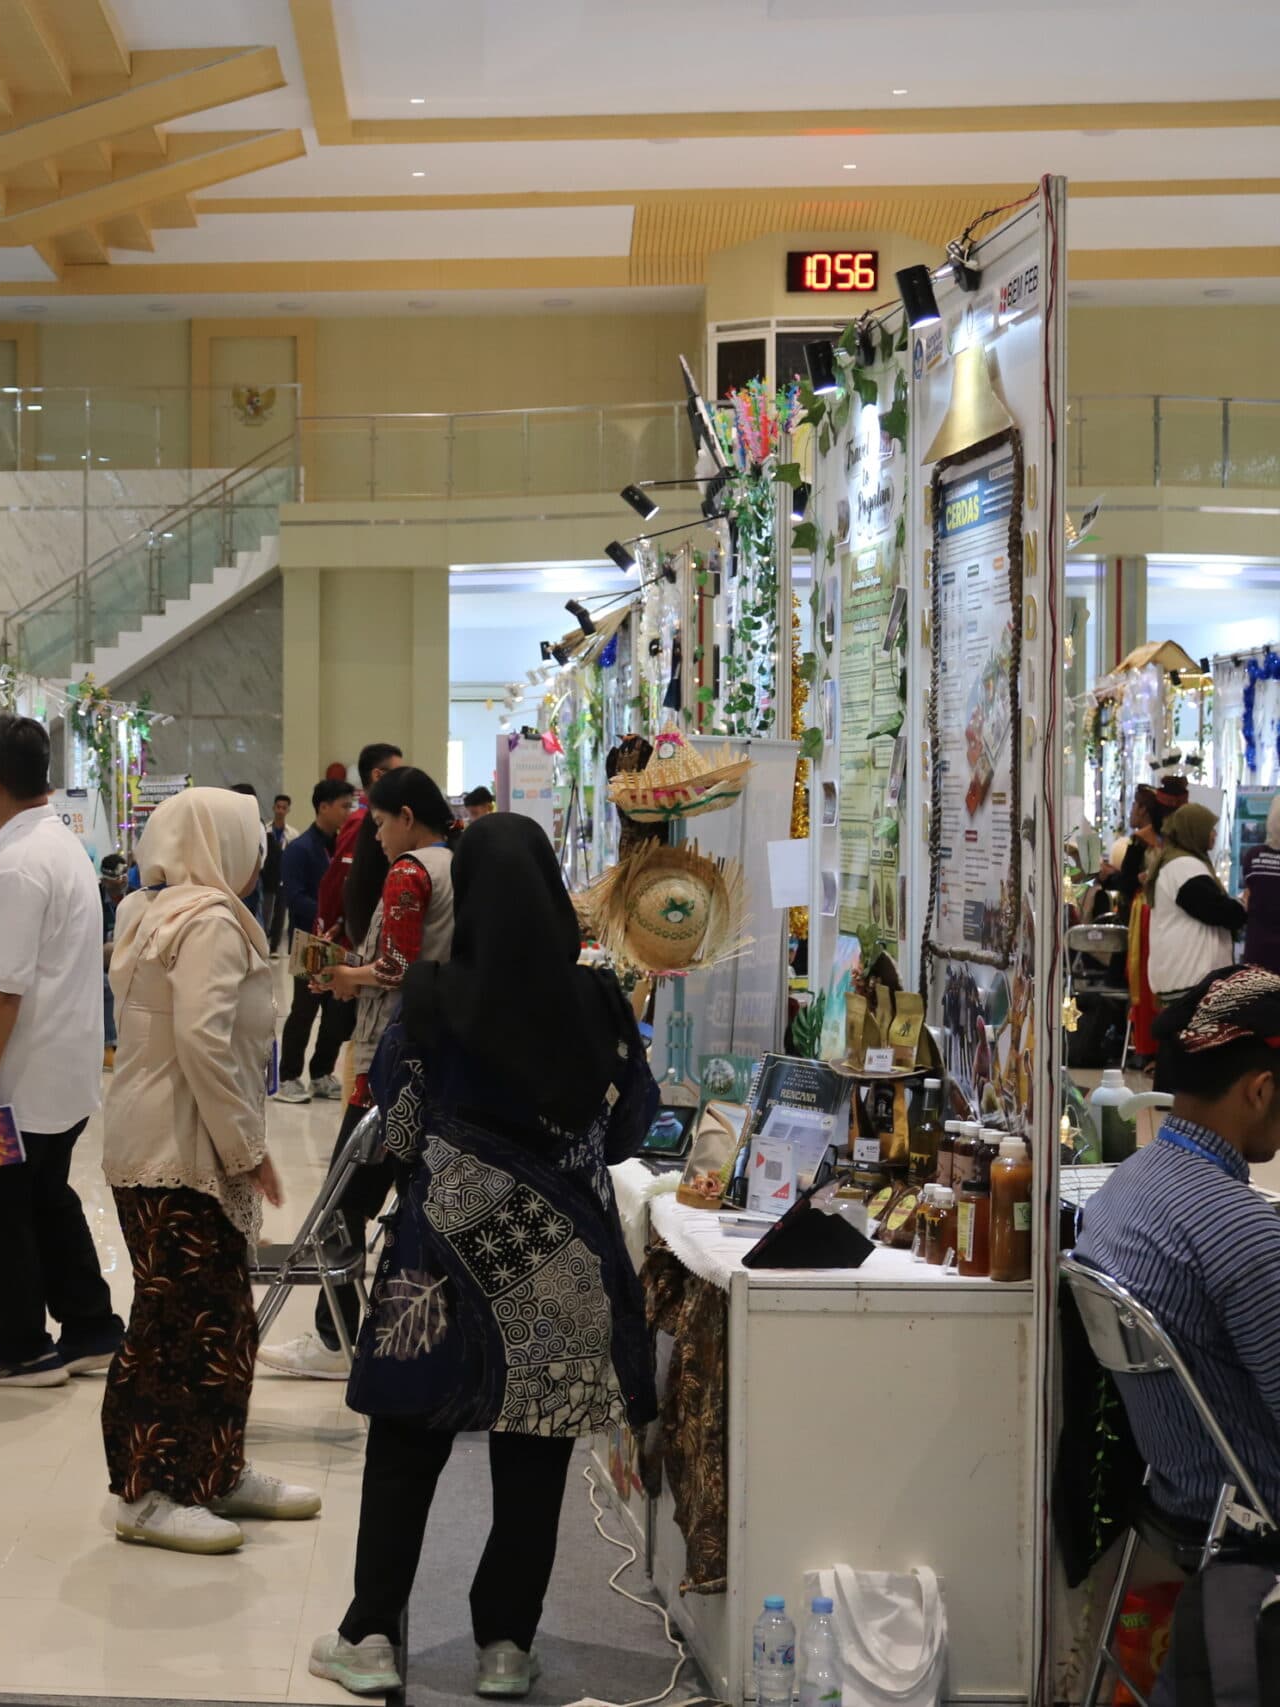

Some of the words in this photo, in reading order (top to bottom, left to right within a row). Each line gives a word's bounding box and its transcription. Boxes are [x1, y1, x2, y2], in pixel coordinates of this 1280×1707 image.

[1007, 276, 1023, 306] BEM
[1024, 265, 1039, 296] FEB
[945, 494, 980, 531] CERDAS
